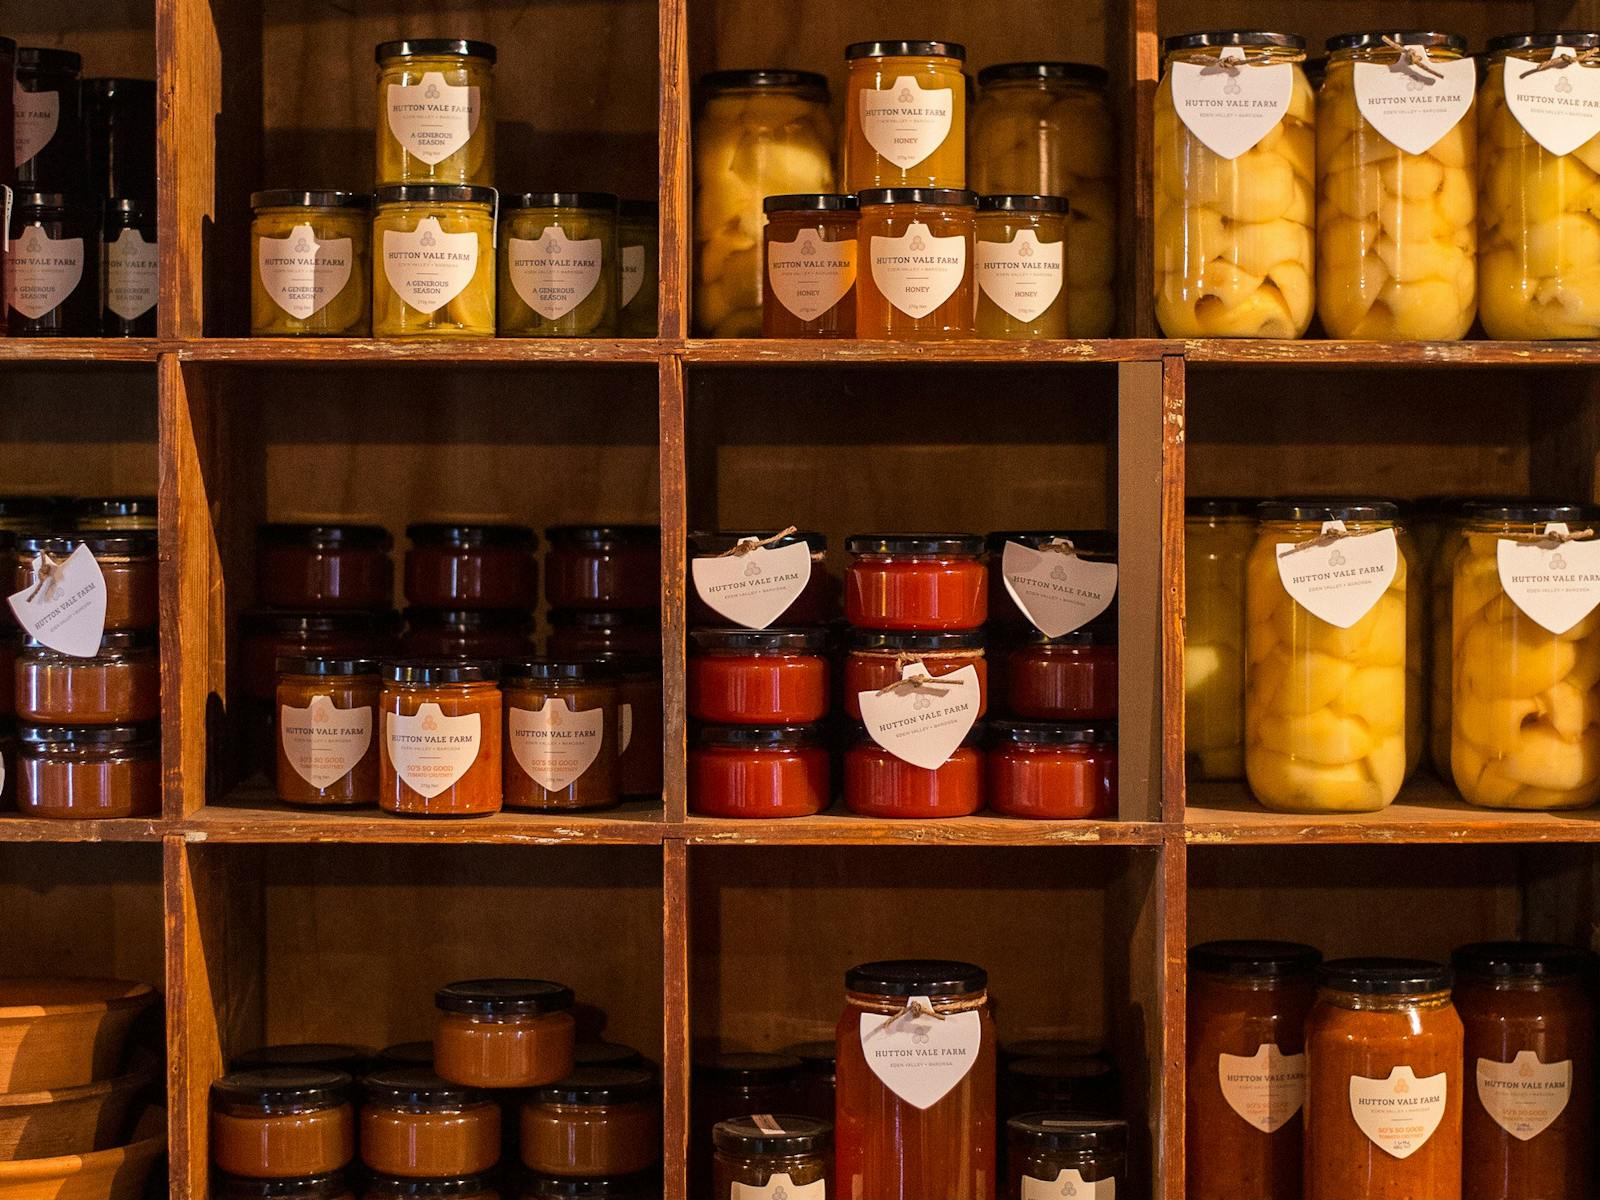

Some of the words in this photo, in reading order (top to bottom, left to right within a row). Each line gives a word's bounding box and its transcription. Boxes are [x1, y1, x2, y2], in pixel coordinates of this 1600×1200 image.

[1185, 99, 1223, 107] HUTTON
[1252, 100, 1277, 108] FARM
[1368, 97, 1407, 105] HUTTON
[1435, 95, 1461, 103] FARM
[1517, 94, 1554, 104] HUTTON
[1557, 98, 1580, 106] VALE
[1583, 100, 1600, 108] FAR
[393, 104, 425, 112] HUTTON
[427, 104, 449, 112] VALE
[865, 108, 899, 117] HUTTON
[447, 253, 470, 261] FARM
[877, 256, 910, 264] HUTTON
[912, 256, 934, 264] VALE
[265, 258, 295, 266] HUTTON
[298, 258, 321, 266] VALE
[515, 259, 547, 267] HUTTON
[548, 259, 570, 267] VALE
[984, 262, 1019, 270] HUTTON
[1292, 572, 1331, 584] HUTTON
[1333, 569, 1357, 578] VALE
[1359, 565, 1384, 574] FARM
[1512, 575, 1549, 583] HUTTON
[708, 582, 746, 593] HUTTON
[749, 577, 772, 586] VALE
[774, 573, 799, 582] FARM
[1013, 576, 1050, 588] HUTTON
[1052, 584, 1075, 594] VALE
[1076, 589, 1101, 600] FARM
[34, 607, 61, 630] HUTTON
[60, 595, 78, 610] VALE
[77, 582, 96, 599] FARM
[879, 717, 917, 732] HUTTON
[919, 710, 942, 721] VALE
[944, 703, 969, 716] FARM
[392, 734, 422, 742] HUTTON
[449, 735, 472, 743] FARM
[550, 730, 572, 738] VALE
[875, 1049, 914, 1057] HUTTON
[941, 1048, 966, 1056] FARM
[1521, 1081, 1542, 1089] VALE
[1420, 1096, 1440, 1104] FARM
